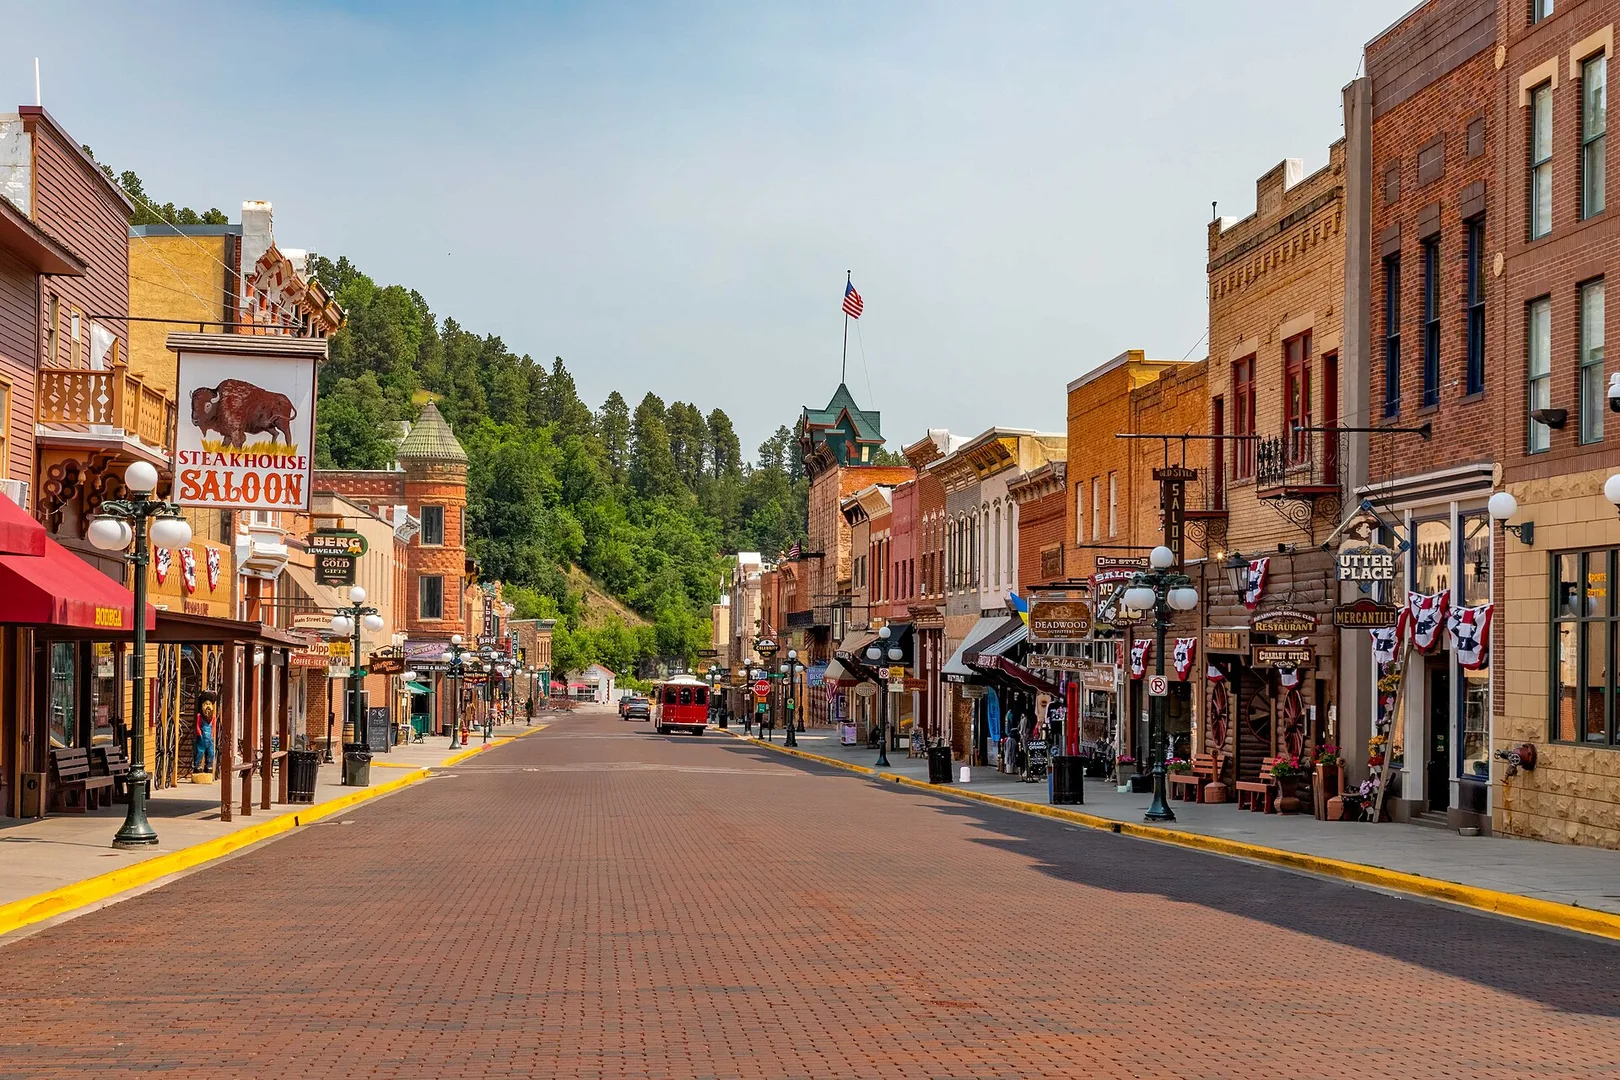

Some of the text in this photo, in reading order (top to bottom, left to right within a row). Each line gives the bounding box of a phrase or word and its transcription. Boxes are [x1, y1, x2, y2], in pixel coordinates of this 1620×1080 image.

[179, 450, 306, 470] STEAKHOUSE
[1173, 469, 1192, 477] STYLE
[180, 469, 304, 504] SALOON
[314, 536, 360, 548] BERG
[1340, 555, 1394, 566] UTTER
[1340, 567, 1393, 580] PLACE
[95, 608, 122, 626] BODEGA
[1336, 612, 1394, 624] MERCANTILE
[1256, 622, 1314, 631] RESTAURANT
[294, 658, 310, 666] COFFEE
[314, 659, 322, 667] ICE
[1052, 658, 1075, 668] Buffalo
[1076, 661, 1089, 670] Bar
